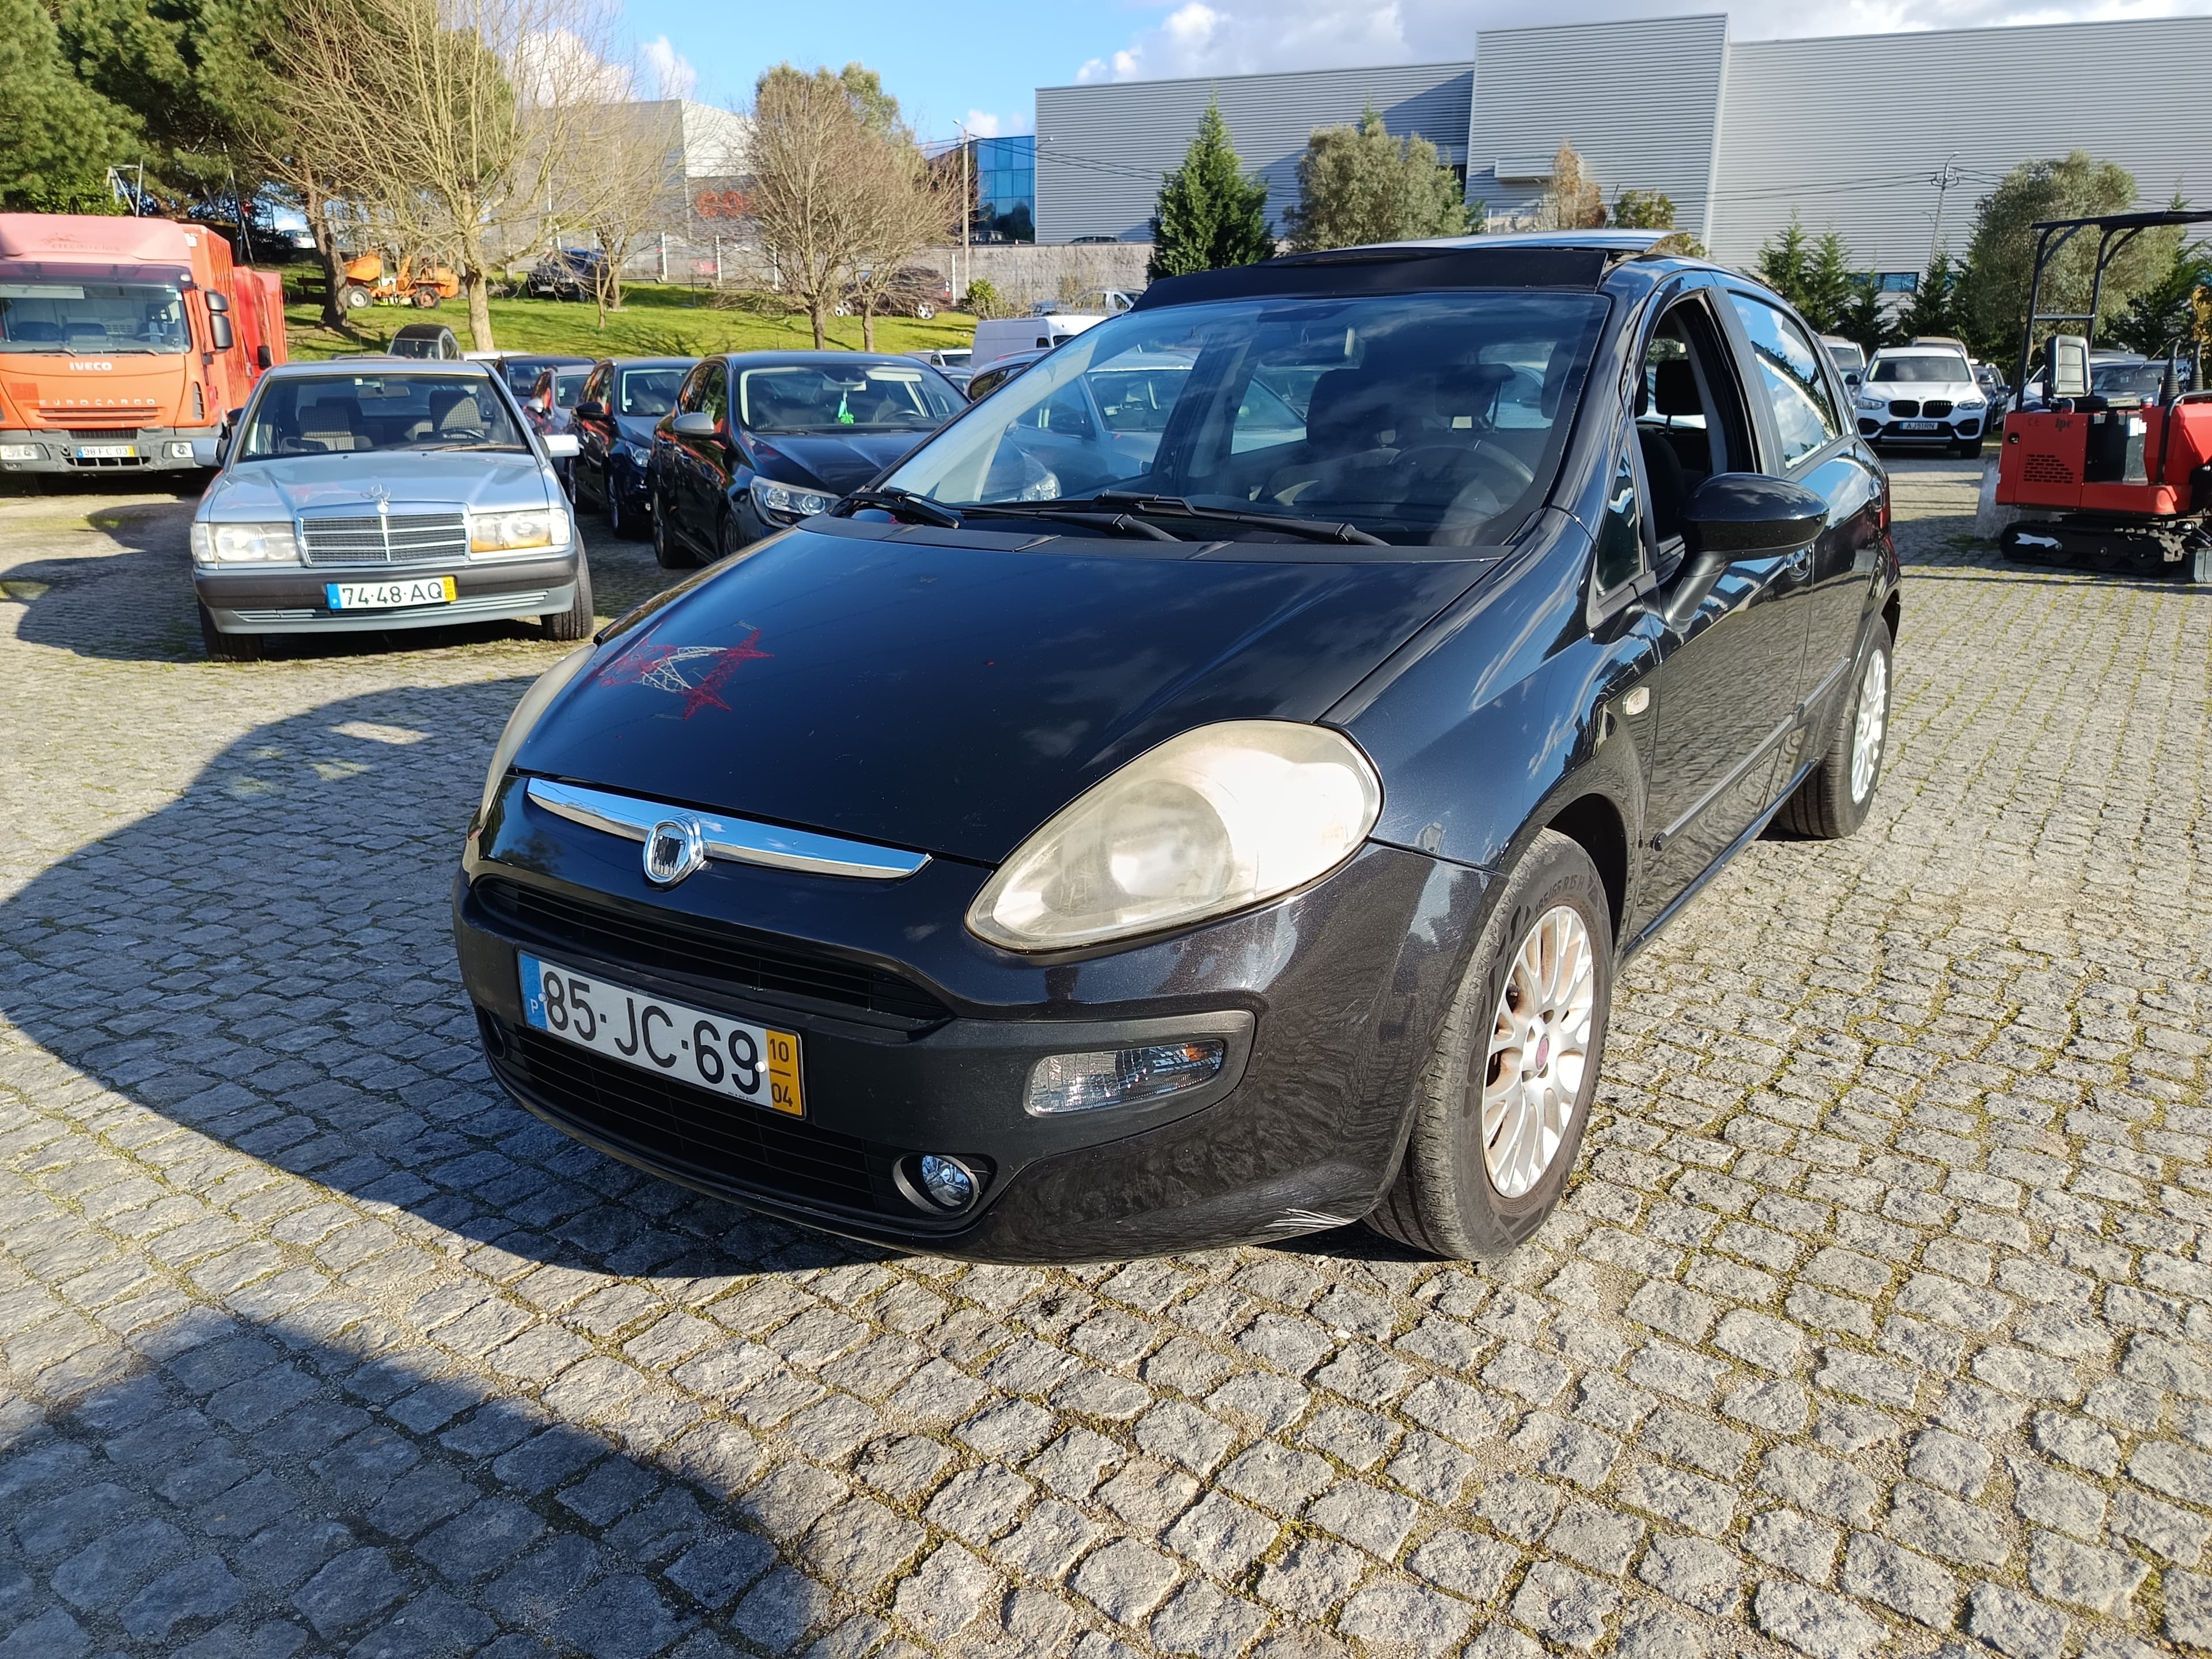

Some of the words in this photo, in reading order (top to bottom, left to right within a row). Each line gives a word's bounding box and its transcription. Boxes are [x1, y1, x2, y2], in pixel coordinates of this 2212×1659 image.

[69, 362, 112, 371] IVECO
[1577, 875, 1585, 892] H
[530, 999, 539, 1014] P
[770, 1038, 789, 1063] 10
[772, 1082, 793, 1107] 04
